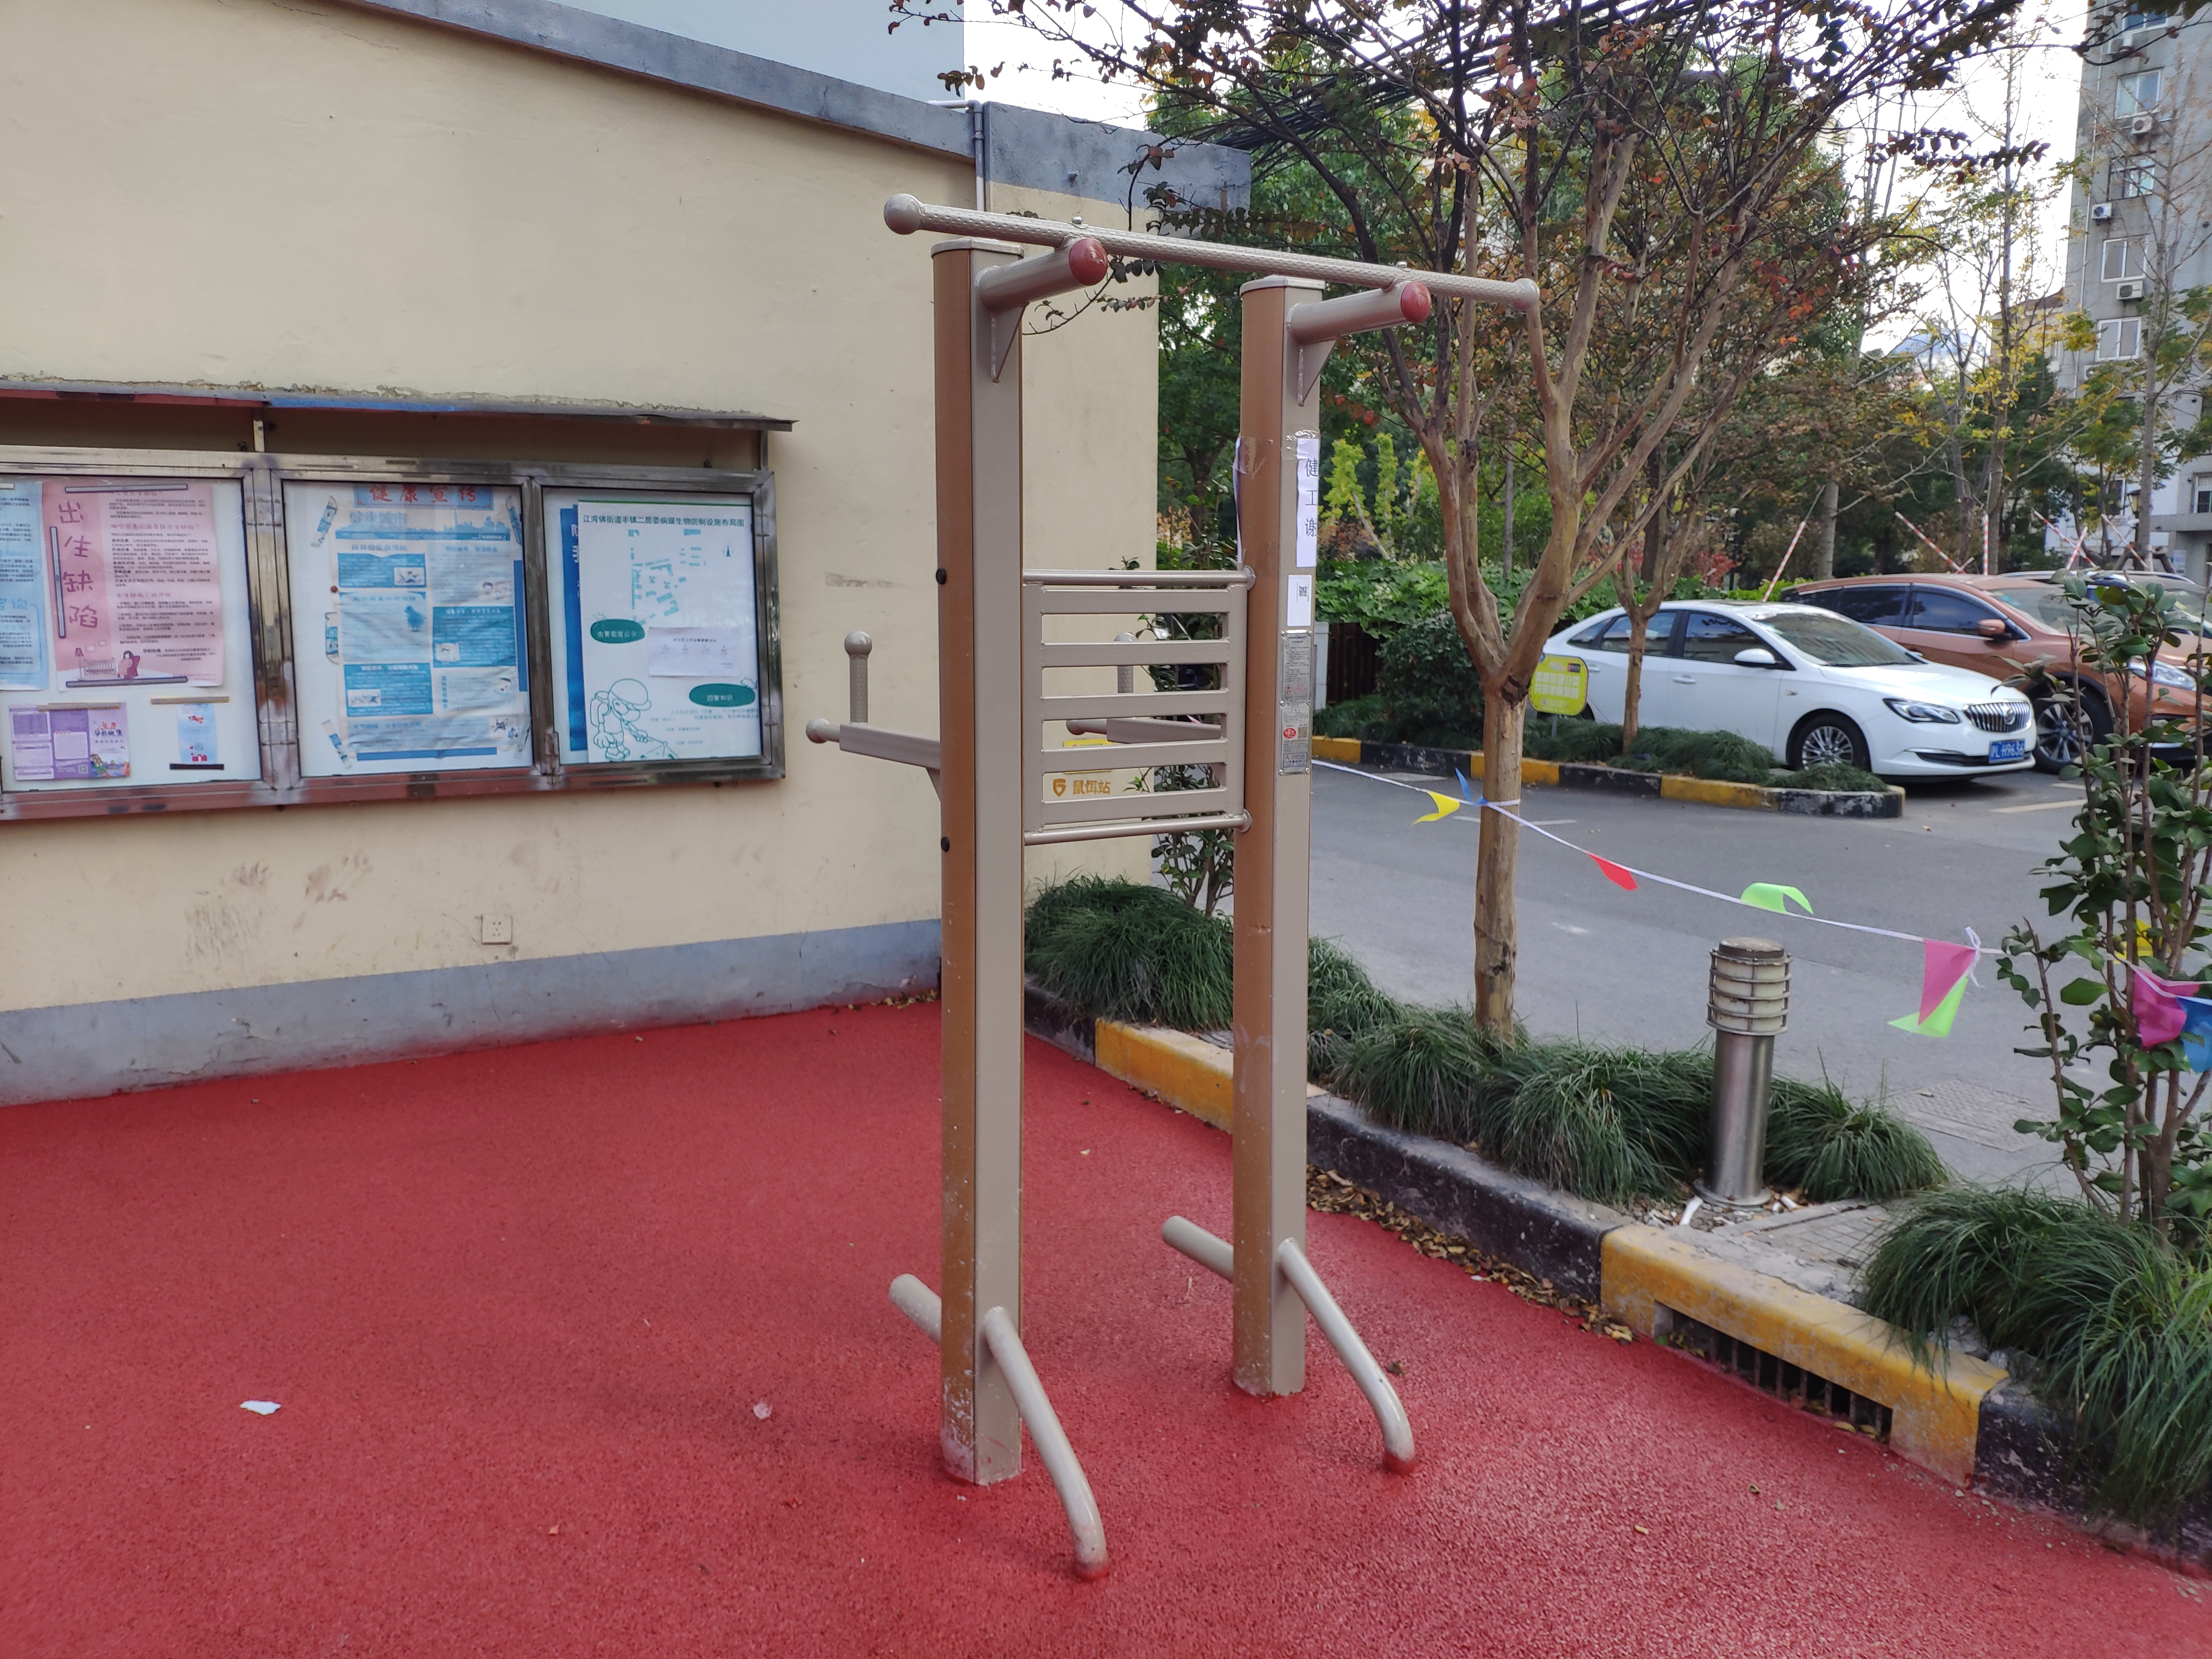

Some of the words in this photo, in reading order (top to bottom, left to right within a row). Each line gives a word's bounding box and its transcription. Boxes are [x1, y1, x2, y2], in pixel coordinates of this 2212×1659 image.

[369, 483, 477, 503] 健康宣传
[58, 501, 98, 628] 出生缺陷
[1073, 780, 1110, 794] 鼠饵站
